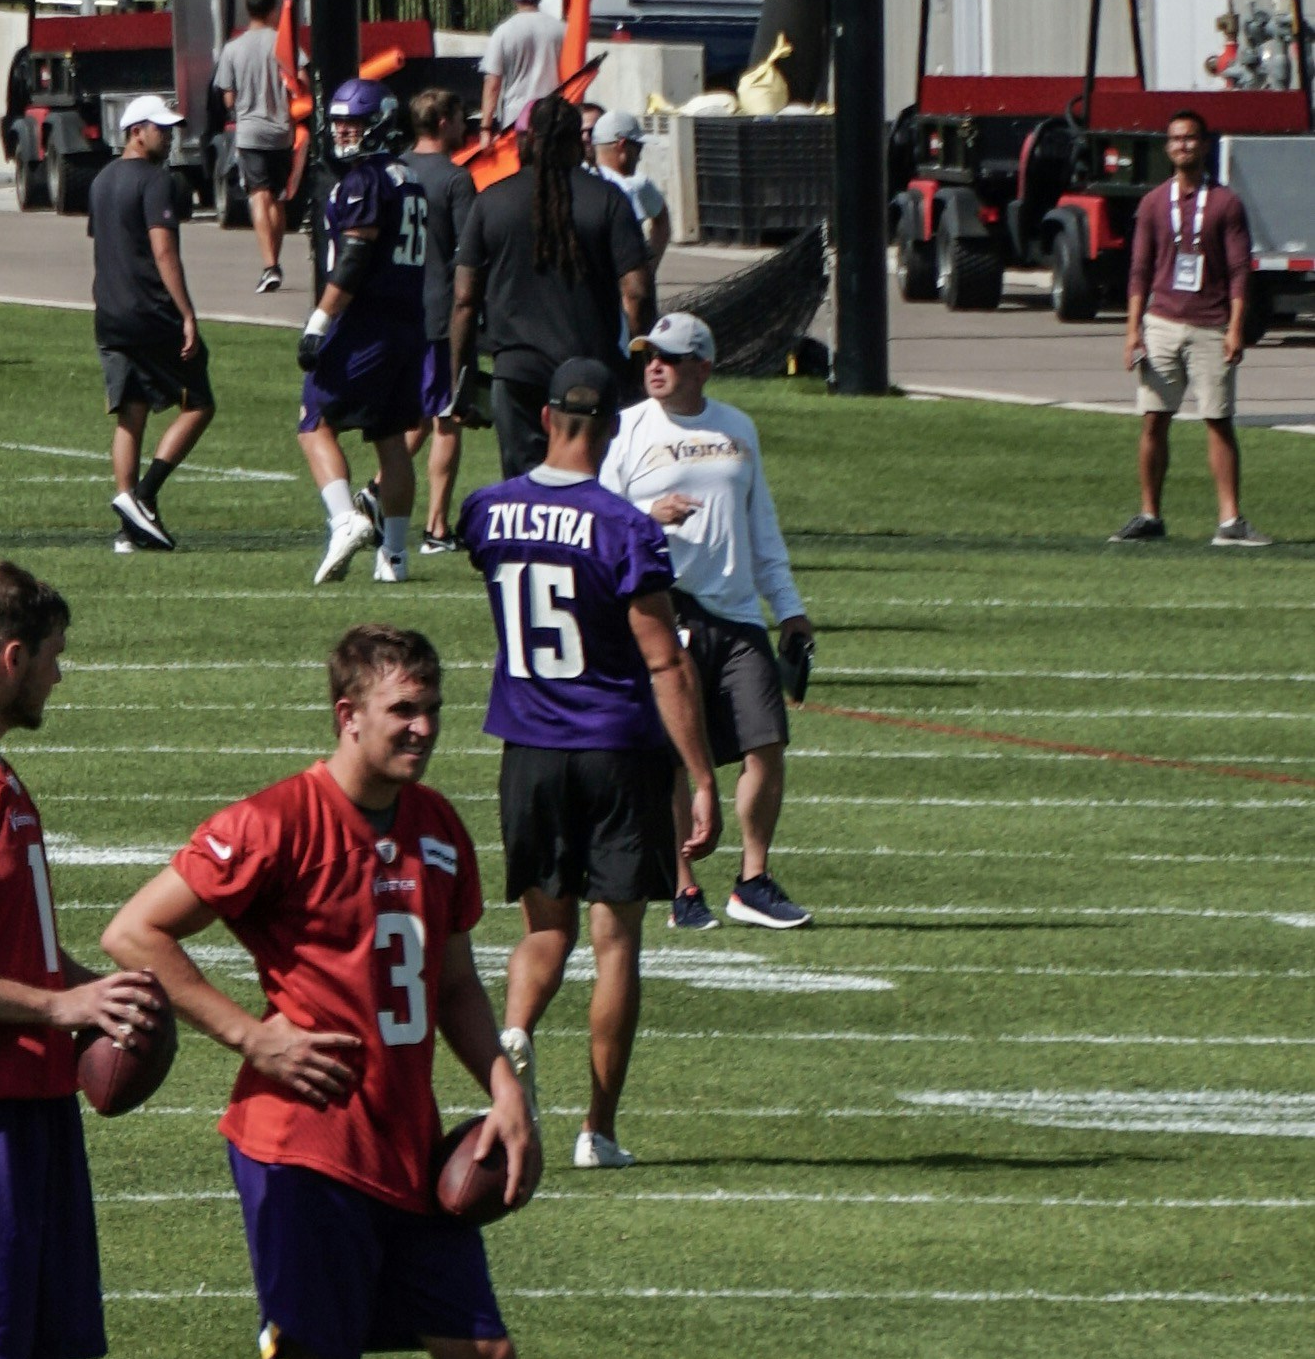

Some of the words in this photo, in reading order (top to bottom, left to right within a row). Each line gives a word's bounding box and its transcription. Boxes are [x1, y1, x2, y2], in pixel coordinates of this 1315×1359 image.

[487, 502, 595, 550] ZYLSTRA
[492, 561, 585, 679] 15
[27, 843, 59, 974] 1
[374, 912, 427, 1046] 3
